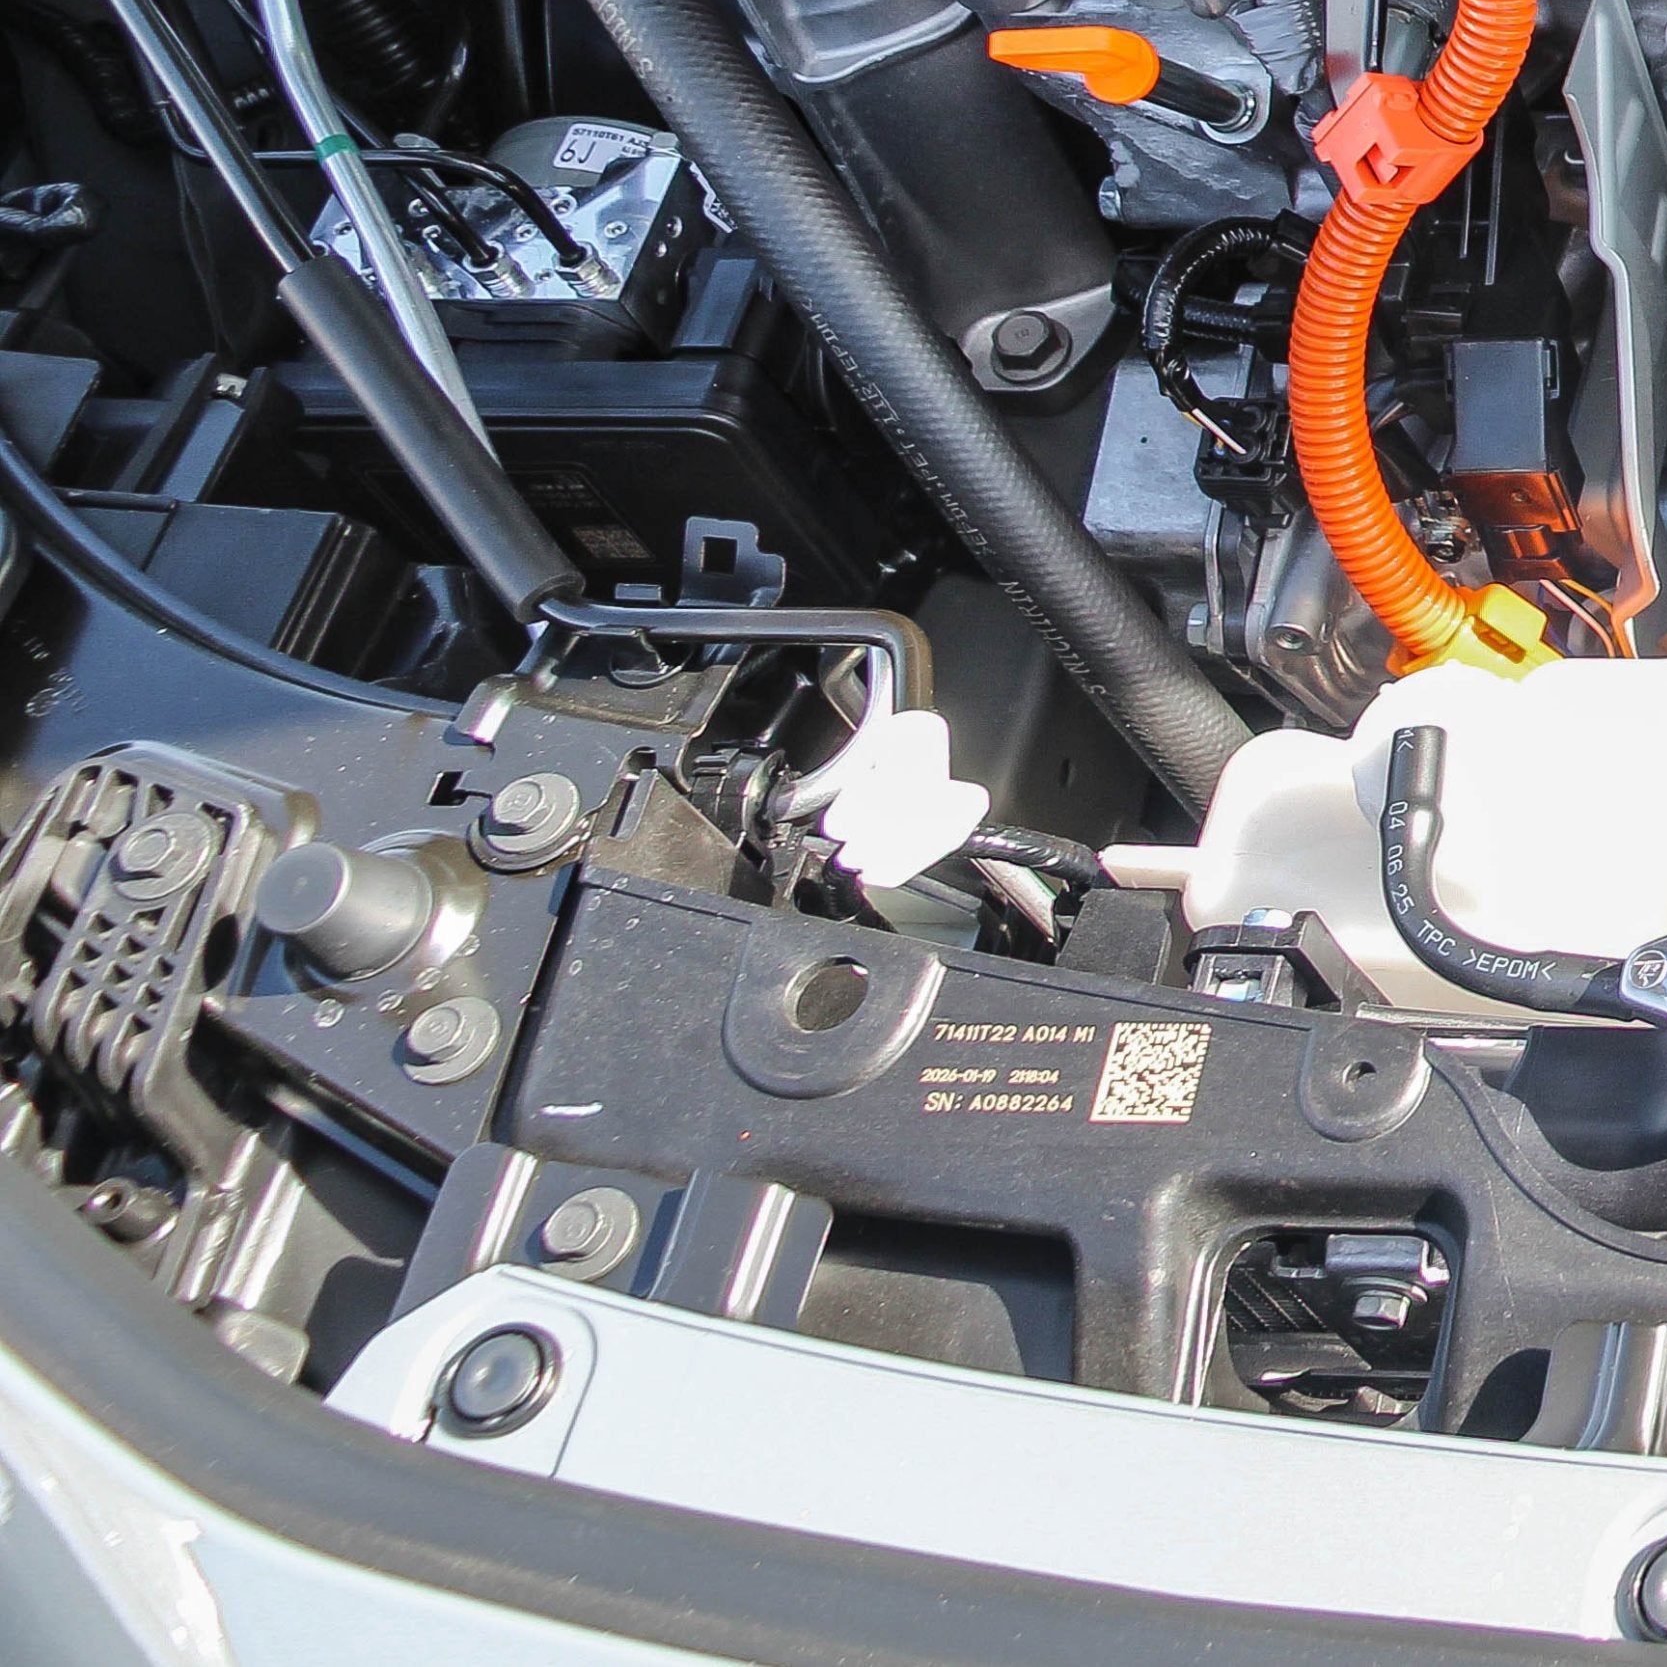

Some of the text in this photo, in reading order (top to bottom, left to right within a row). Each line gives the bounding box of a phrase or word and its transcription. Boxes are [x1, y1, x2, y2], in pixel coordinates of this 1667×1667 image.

[560, 138, 597, 164] 6J
[1388, 800, 1408, 830] 04
[1387, 844, 1404, 876] 06
[1390, 883, 1416, 916] 25
[934, 1023, 1018, 1044] 71411T22
[1021, 1024, 1069, 1044] A014
[924, 1091, 1075, 1113] SN: A0882264
